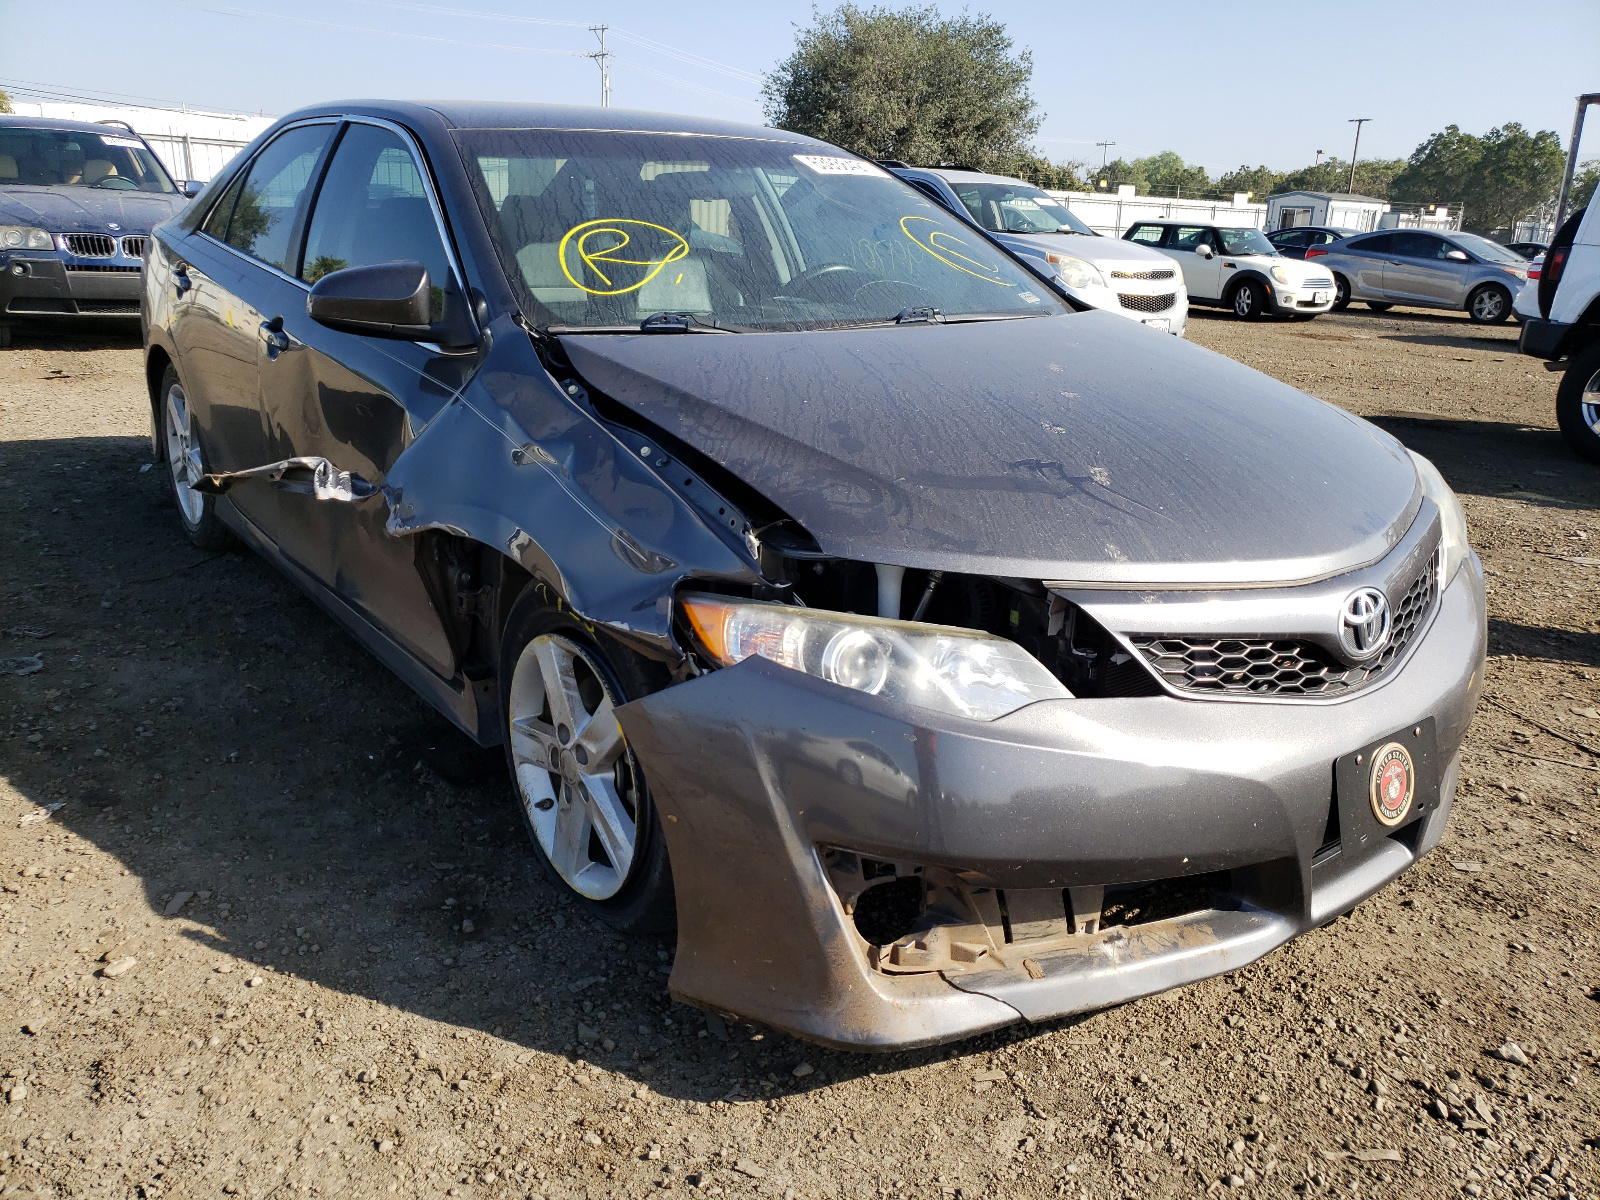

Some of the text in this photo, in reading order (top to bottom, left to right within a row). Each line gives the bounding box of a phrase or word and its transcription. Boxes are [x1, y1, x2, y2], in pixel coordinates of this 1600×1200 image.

[1376, 750, 1410, 784] UNITED STATES
[1379, 791, 1410, 819] MARINE CORPS
